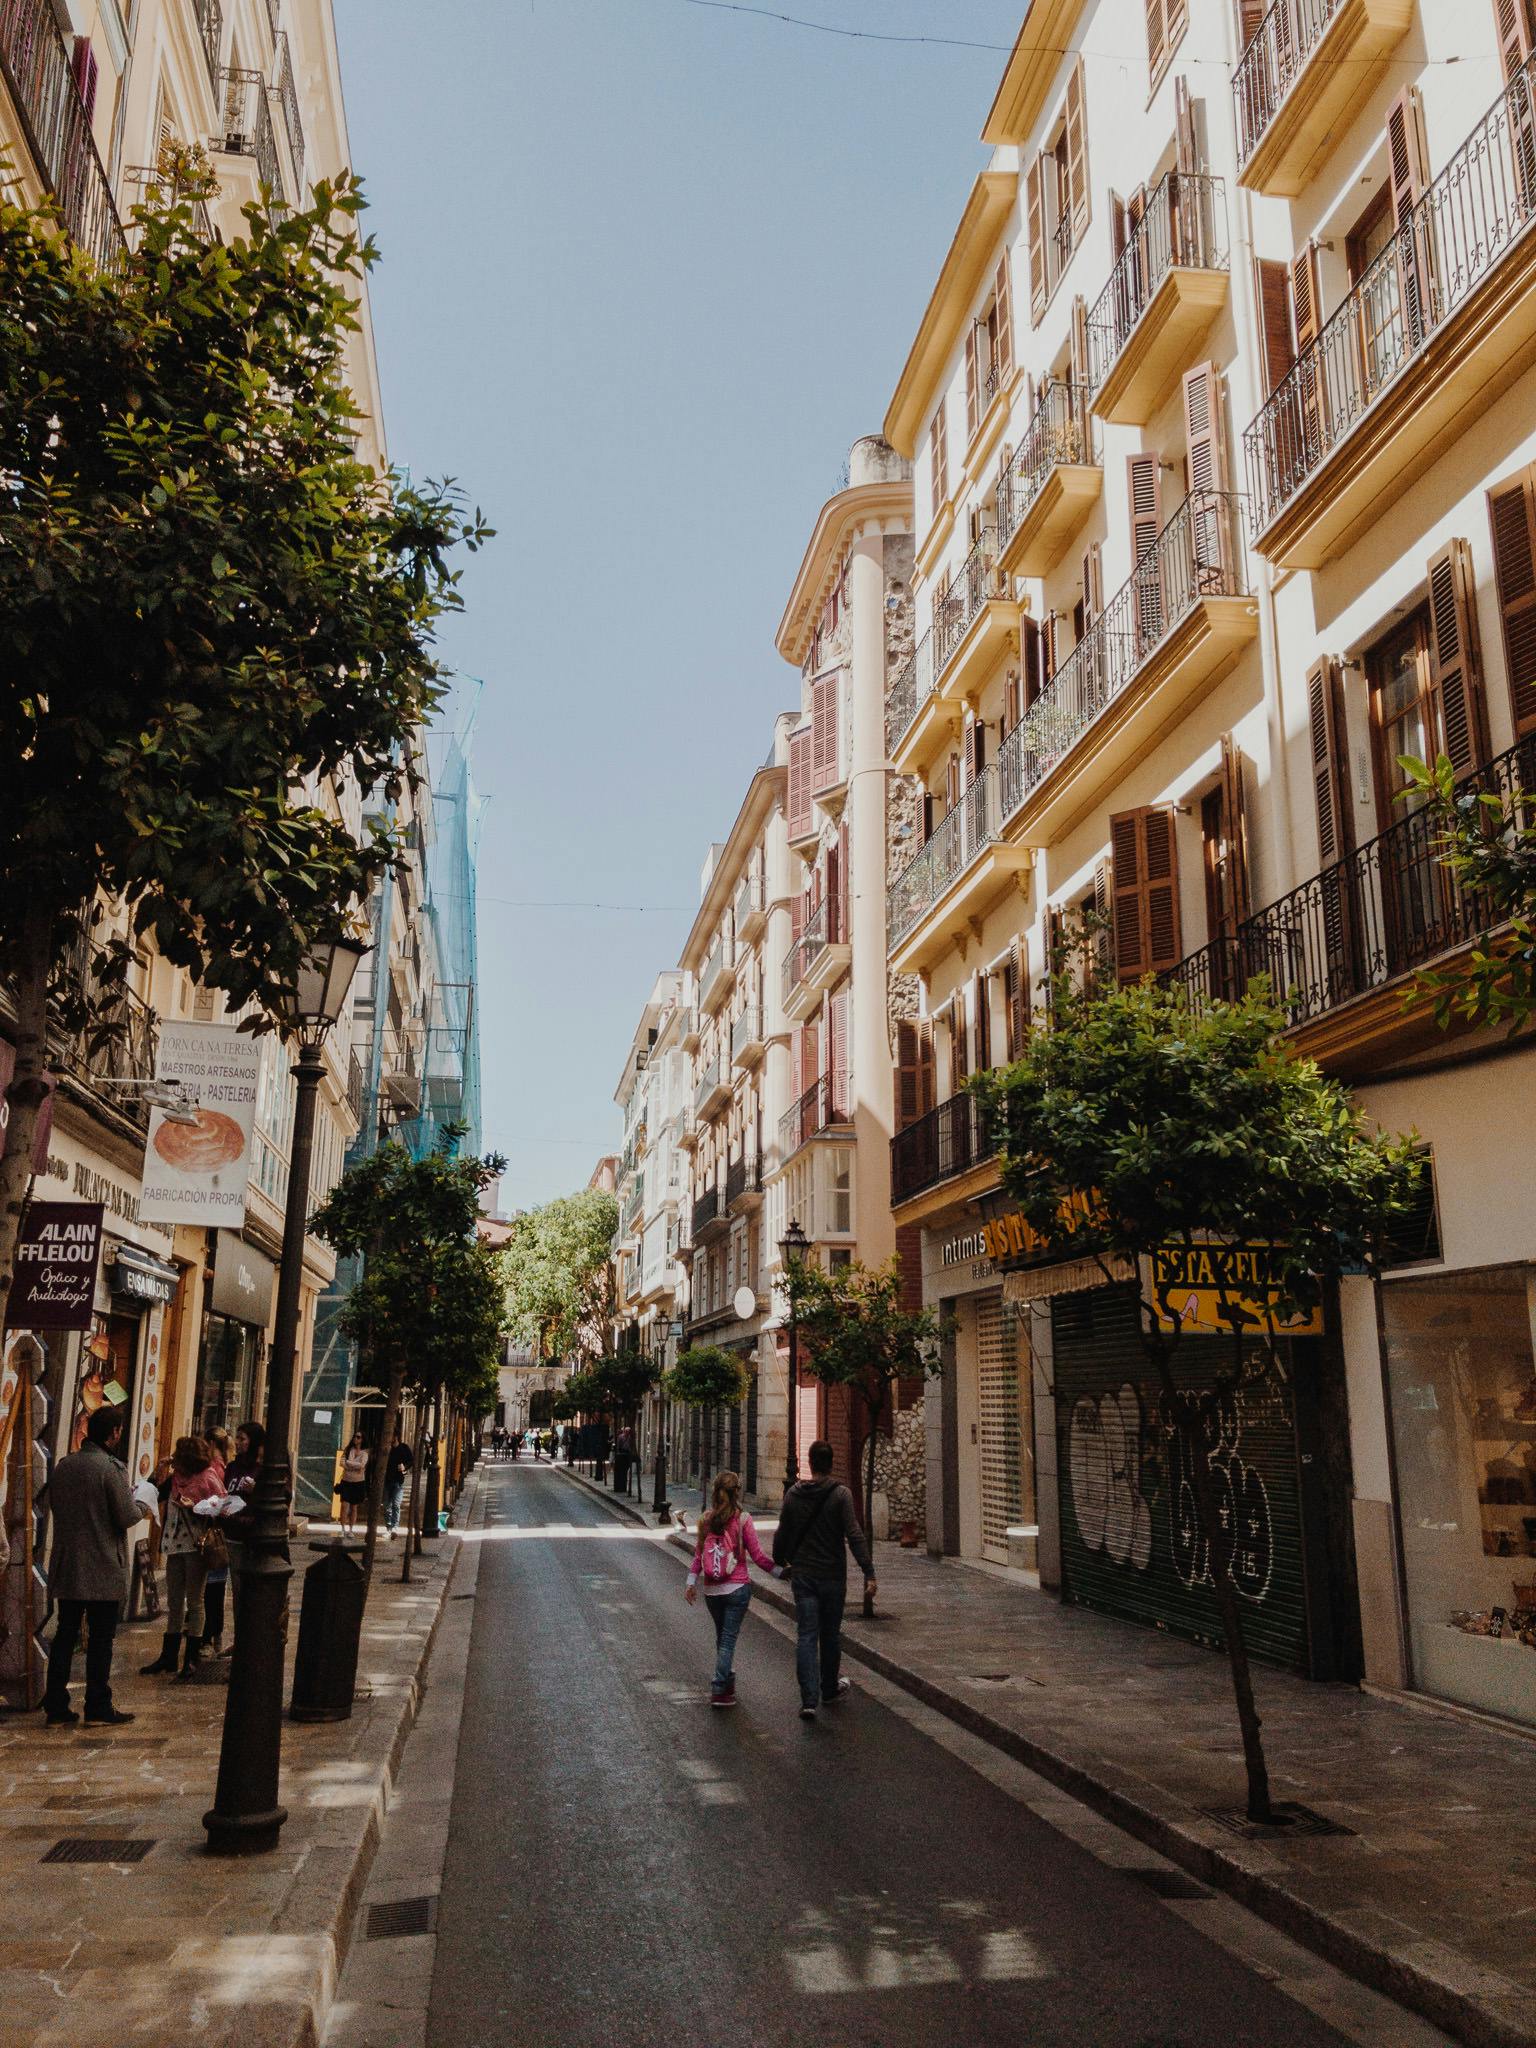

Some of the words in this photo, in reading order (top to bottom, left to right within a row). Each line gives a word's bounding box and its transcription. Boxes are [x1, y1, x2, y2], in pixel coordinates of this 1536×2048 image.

[223, 1042, 260, 1057] TERESA
[161, 1062, 206, 1076] MAESTROS
[207, 1065, 257, 1080] ARTESANOS
[208, 1084, 257, 1103] PASTELERIA
[209, 1192, 244, 1206] PROPIA
[38, 1224, 97, 1242] ALAIN
[17, 1244, 95, 1263] FFLELOU
[81, 1276, 91, 1290] y
